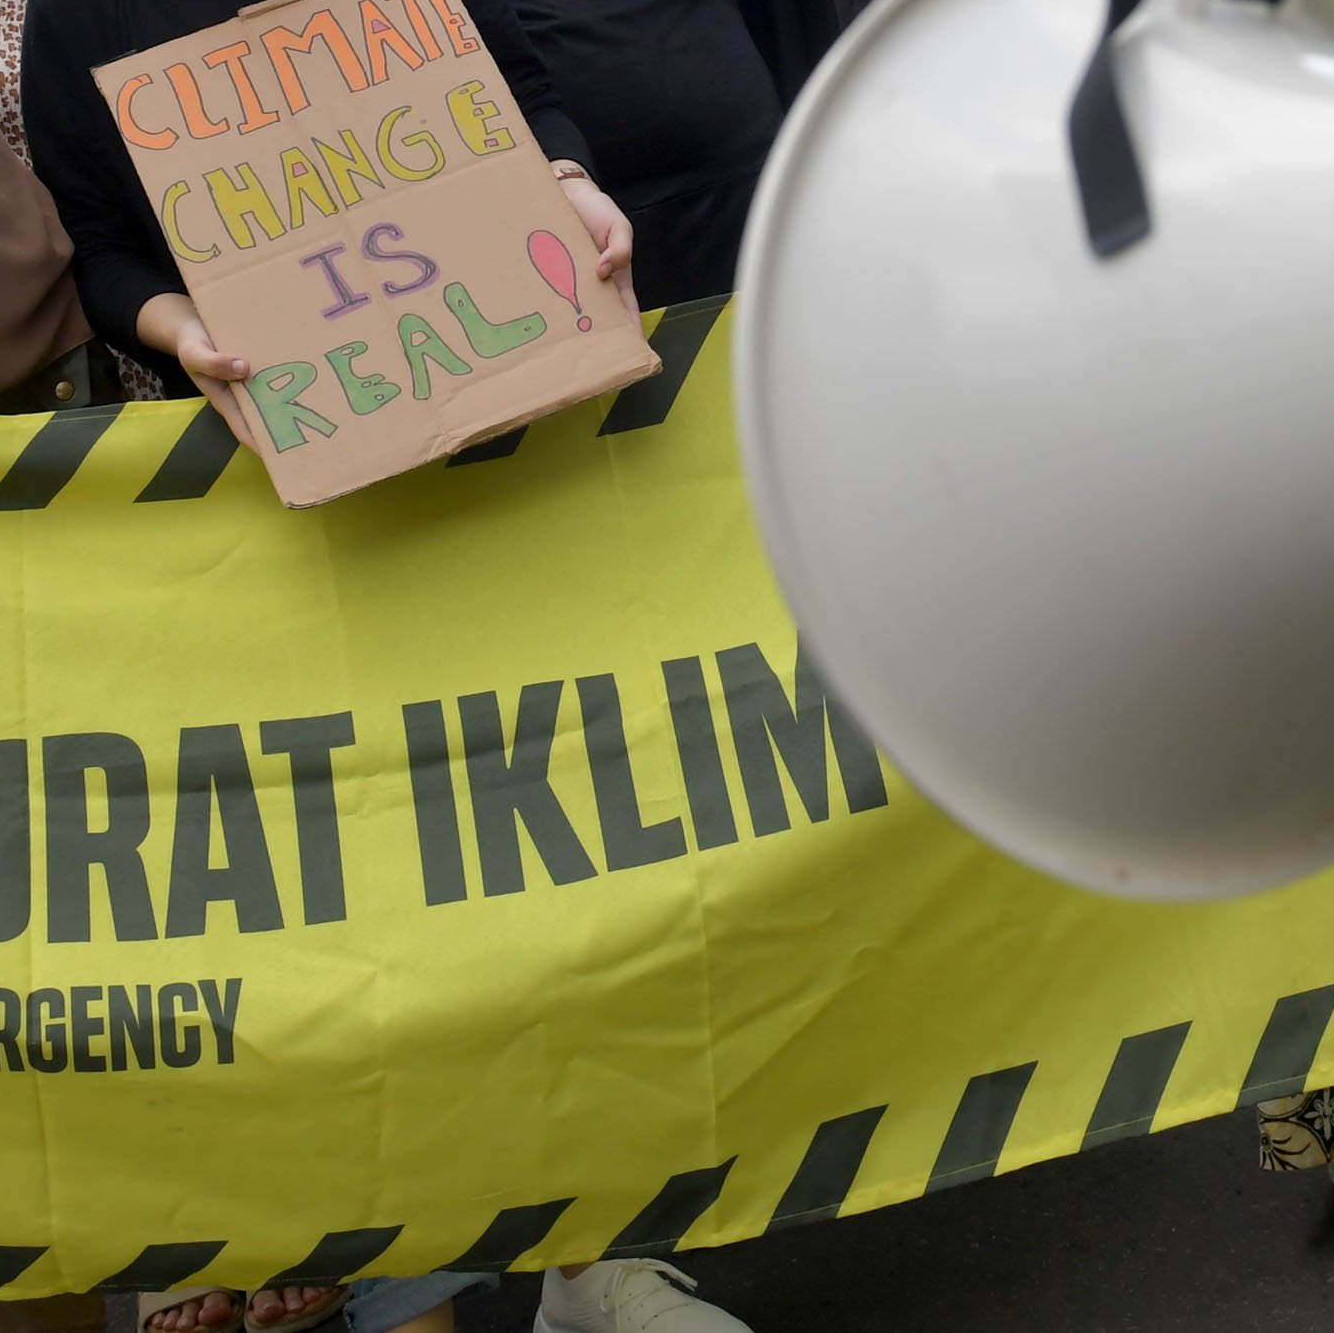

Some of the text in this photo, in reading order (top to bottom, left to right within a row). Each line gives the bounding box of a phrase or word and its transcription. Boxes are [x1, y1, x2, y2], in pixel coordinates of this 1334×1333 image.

[160, 79, 517, 263] CHANGE
[299, 222, 441, 320] IS
[402, 627, 889, 908] IKLIM
